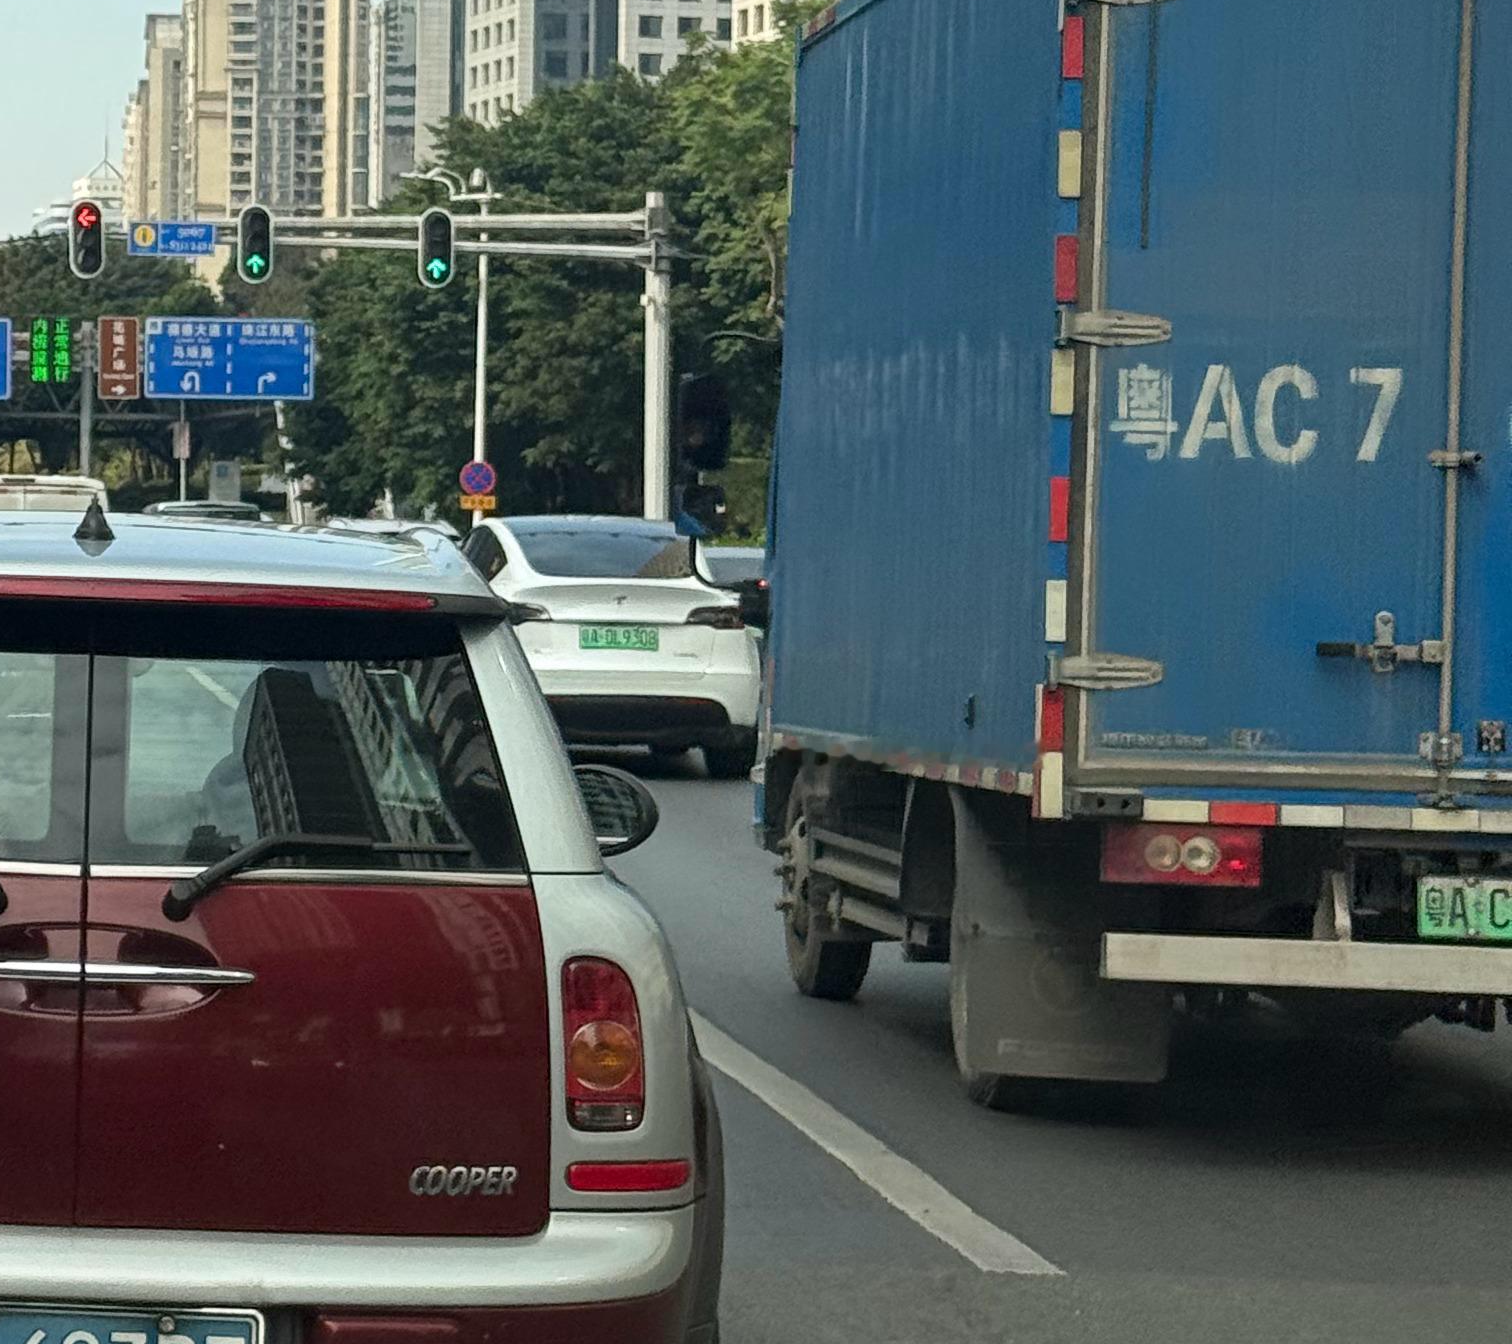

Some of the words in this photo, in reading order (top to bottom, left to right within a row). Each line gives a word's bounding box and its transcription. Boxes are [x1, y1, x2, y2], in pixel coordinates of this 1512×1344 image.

[54, 317, 70, 383] 正常通行
[408, 1165, 517, 1196] COOPER
